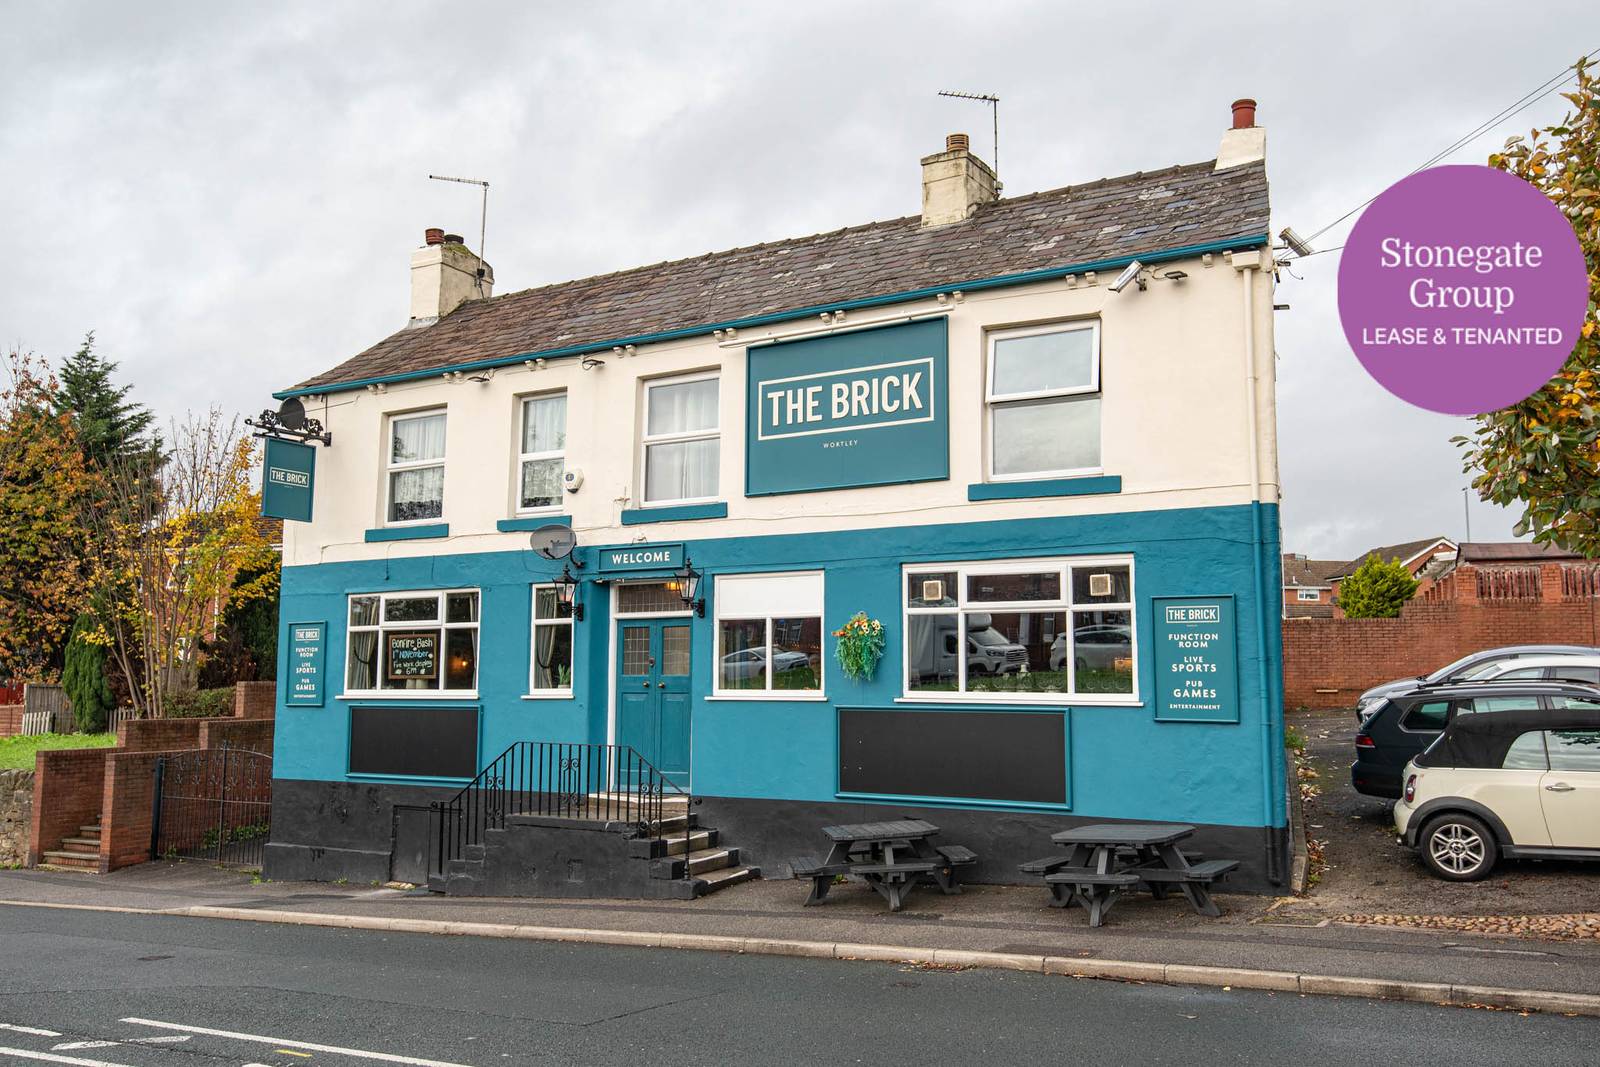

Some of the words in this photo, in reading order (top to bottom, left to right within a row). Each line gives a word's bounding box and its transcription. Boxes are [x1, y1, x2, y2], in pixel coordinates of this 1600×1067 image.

[767, 384, 823, 427] THE
[831, 371, 923, 419] BRICK
[823, 440, 858, 449] WORTLEY
[272, 470, 285, 481] THE
[286, 473, 307, 484] BRICK
[612, 551, 671, 565] WELCOME
[1168, 609, 1186, 620] THE
[1188, 608, 1217, 620] BRICK
[416, 637, 433, 648] Bash
[1168, 633, 1219, 641] FUNCTION
[1171, 664, 1217, 672] SPORTS
[1173, 689, 1217, 698] GAMES
